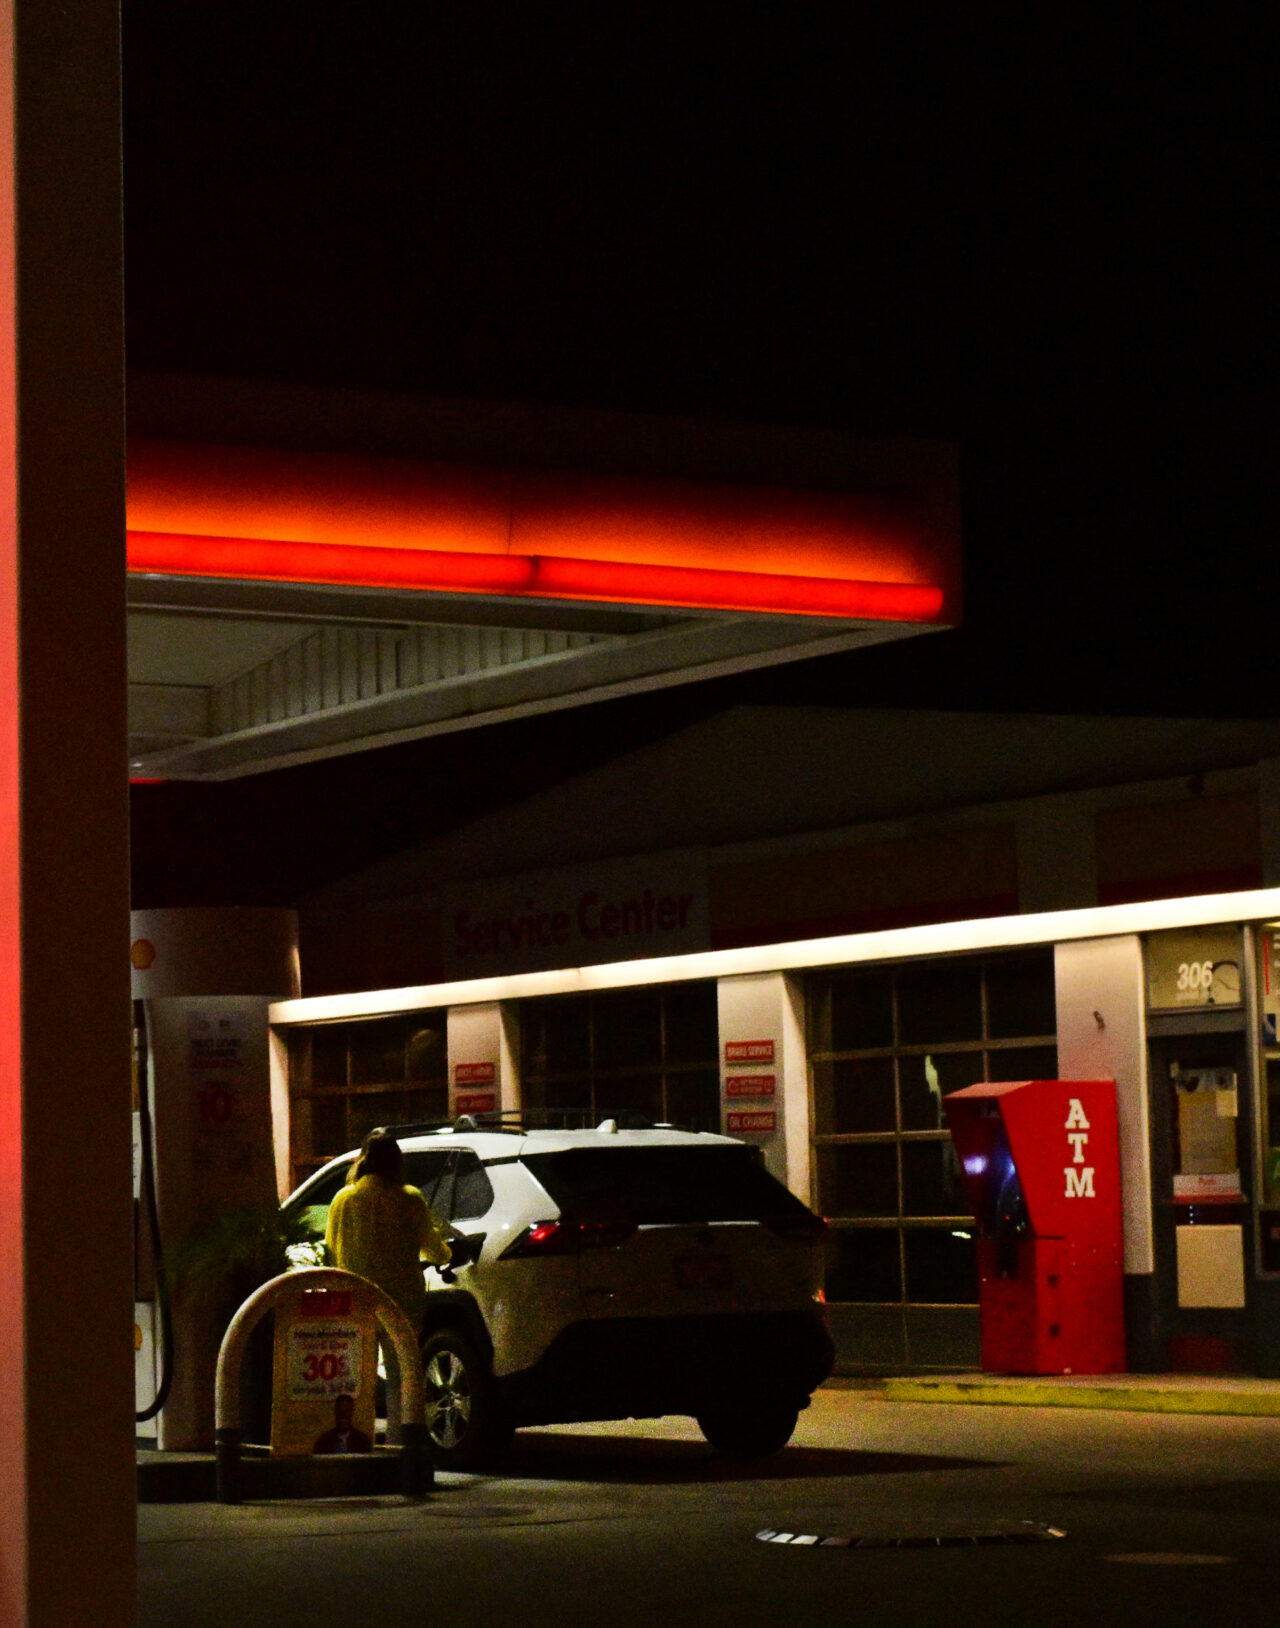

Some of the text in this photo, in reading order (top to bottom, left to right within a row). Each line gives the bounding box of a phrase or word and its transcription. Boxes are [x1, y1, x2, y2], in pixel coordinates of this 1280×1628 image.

[452, 888, 694, 957] Service Center
[1177, 960, 1213, 990] 306
[1064, 1098, 1096, 1198] ATM
